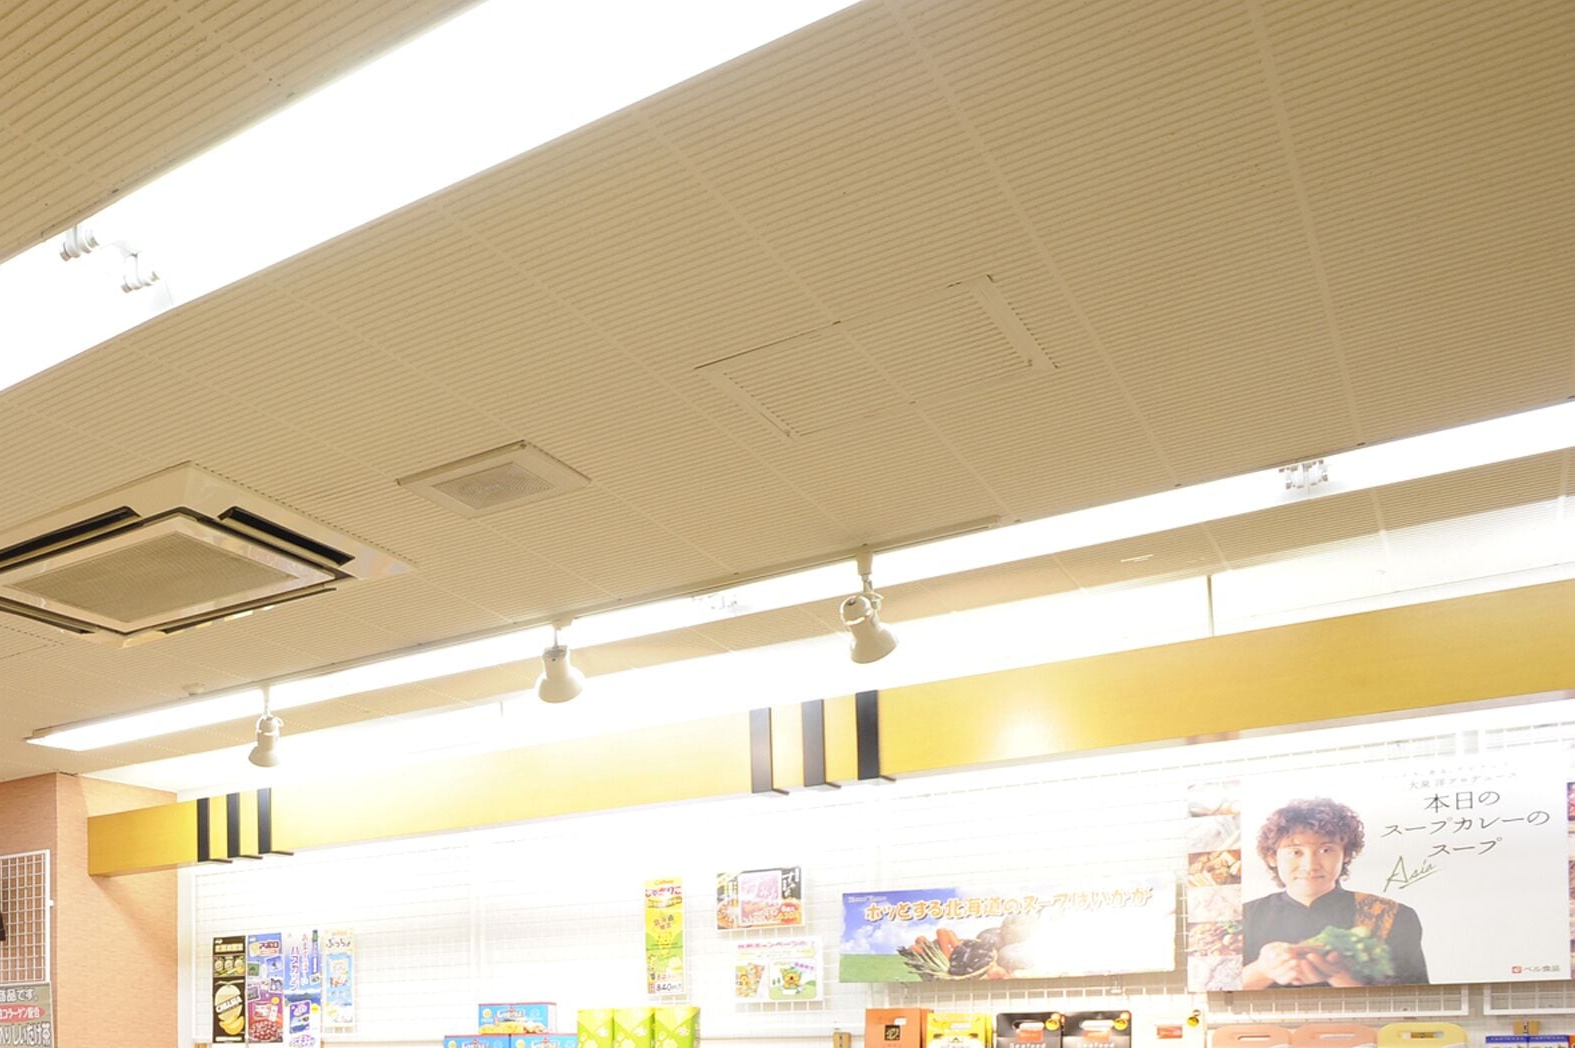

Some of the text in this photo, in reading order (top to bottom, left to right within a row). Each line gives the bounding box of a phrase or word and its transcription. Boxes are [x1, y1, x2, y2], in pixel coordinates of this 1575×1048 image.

[1423, 790, 1500, 814] 本日の
[1380, 810, 1550, 838] スープカレーの
[1427, 836, 1503, 858] スープ
